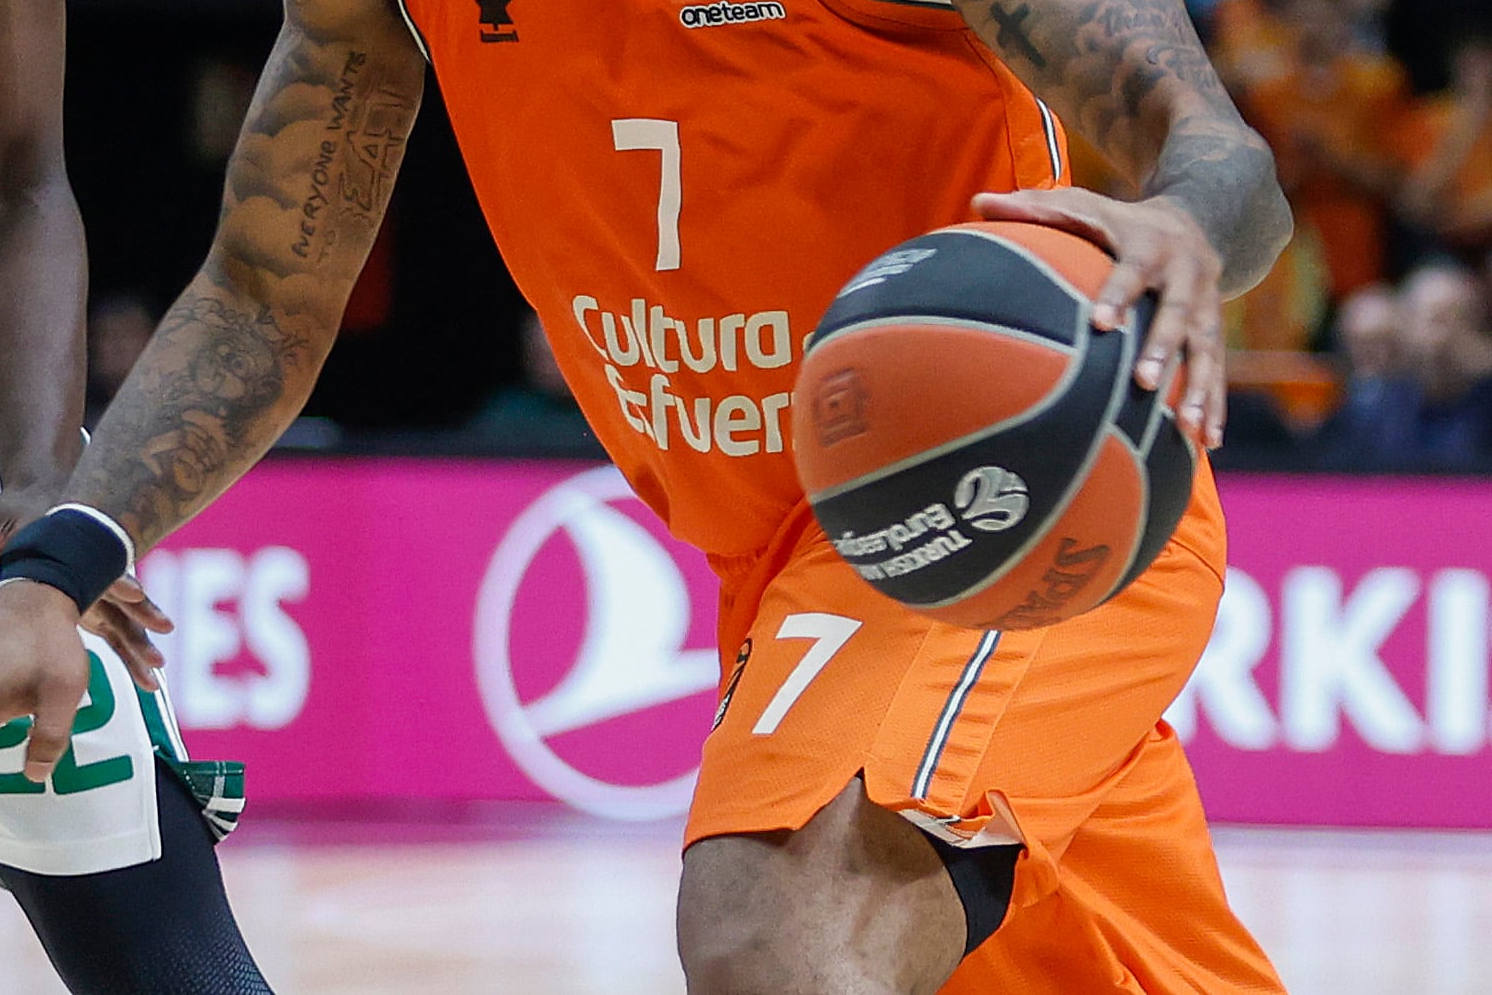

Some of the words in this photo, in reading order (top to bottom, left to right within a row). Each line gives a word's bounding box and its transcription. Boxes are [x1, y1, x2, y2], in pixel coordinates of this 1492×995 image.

[681, 1, 785, 27] oneteam
[611, 118, 682, 271] 7
[572, 294, 793, 374] Cultura
[751, 612, 864, 735] 7
[1161, 564, 1492, 757] RKI
